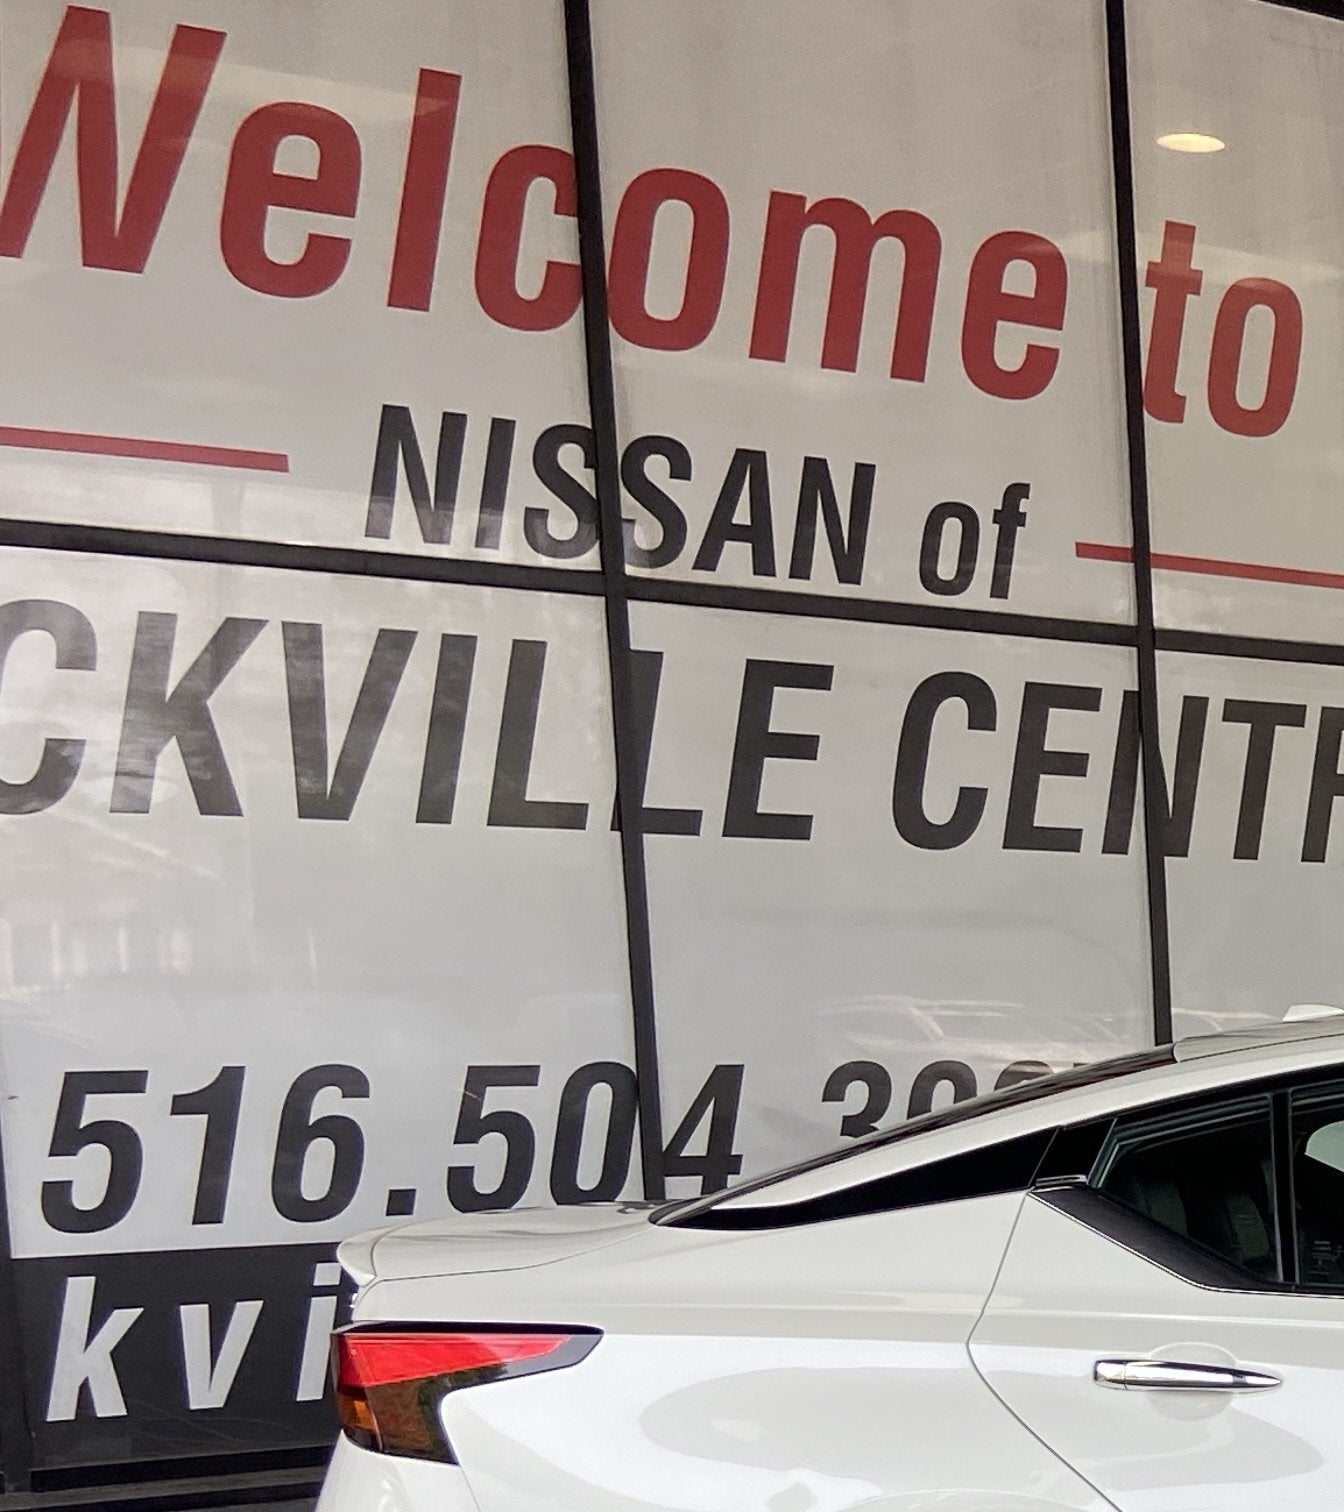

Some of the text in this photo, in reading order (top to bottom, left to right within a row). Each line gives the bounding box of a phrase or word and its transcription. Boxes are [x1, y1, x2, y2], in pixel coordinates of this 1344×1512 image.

[0, 5, 1304, 438] Welcome to
[364, 404, 1031, 600] NISSAN of
[0, 600, 835, 841] CKVILLE
